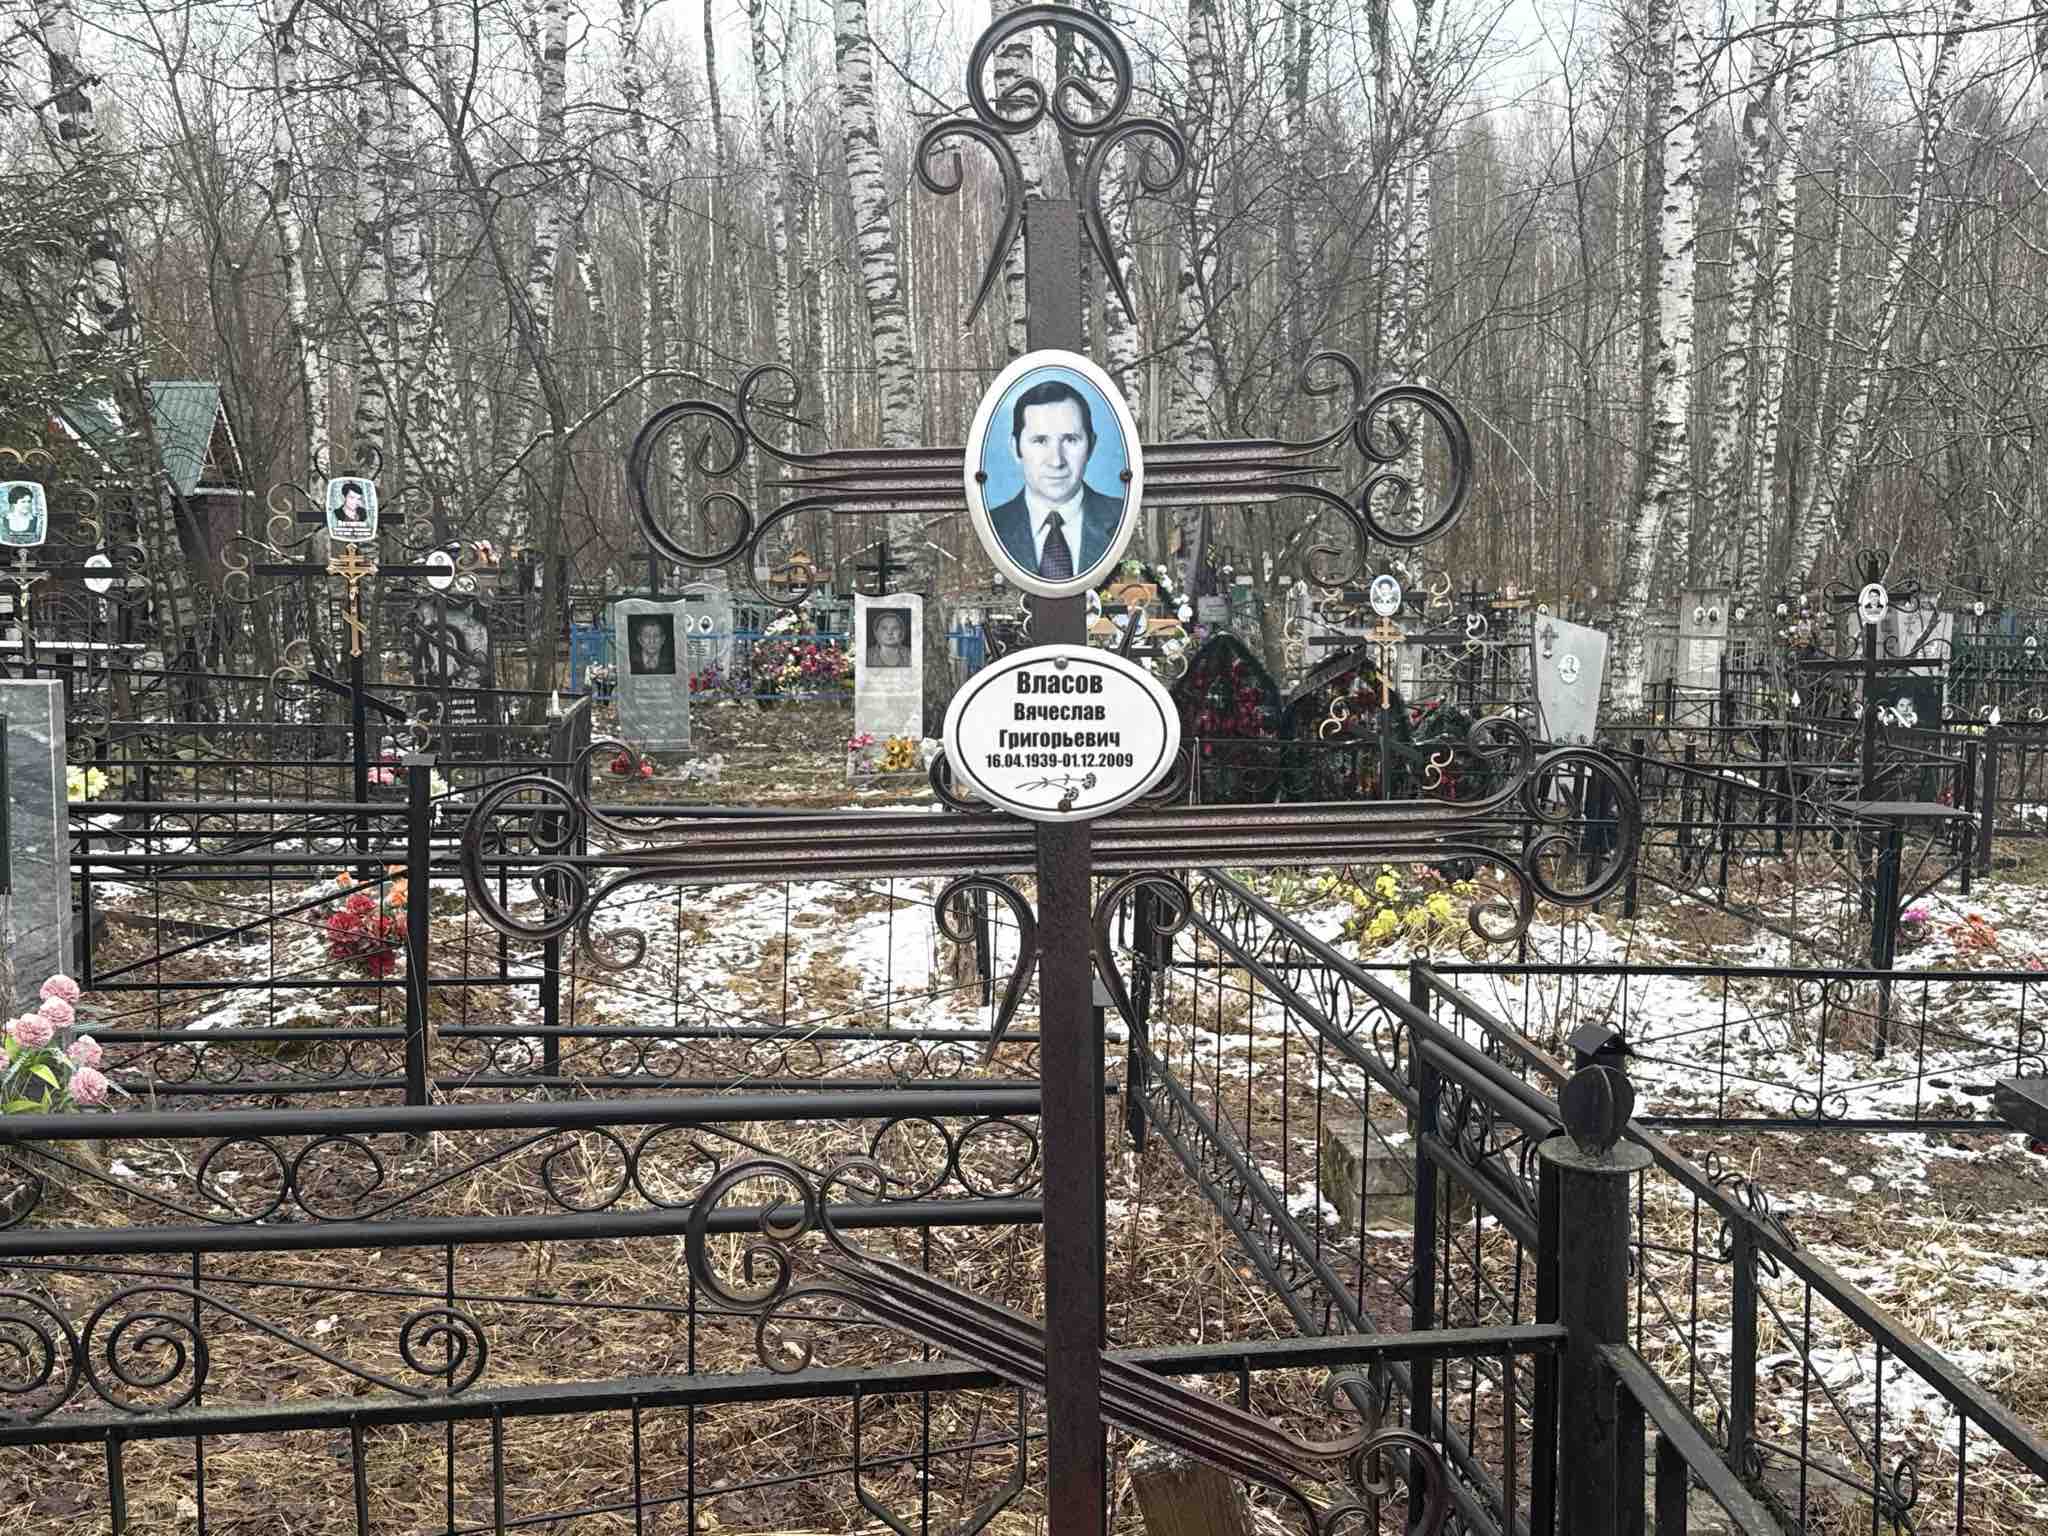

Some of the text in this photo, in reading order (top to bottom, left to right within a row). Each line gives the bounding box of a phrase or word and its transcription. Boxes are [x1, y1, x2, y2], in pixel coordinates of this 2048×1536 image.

[1016, 671, 1103, 694] Власов
[1013, 703, 1106, 721] Вячеслав
[999, 730, 1120, 749] Григорьевич
[985, 753, 1133, 768] 16.04.1939-01.12.2009
